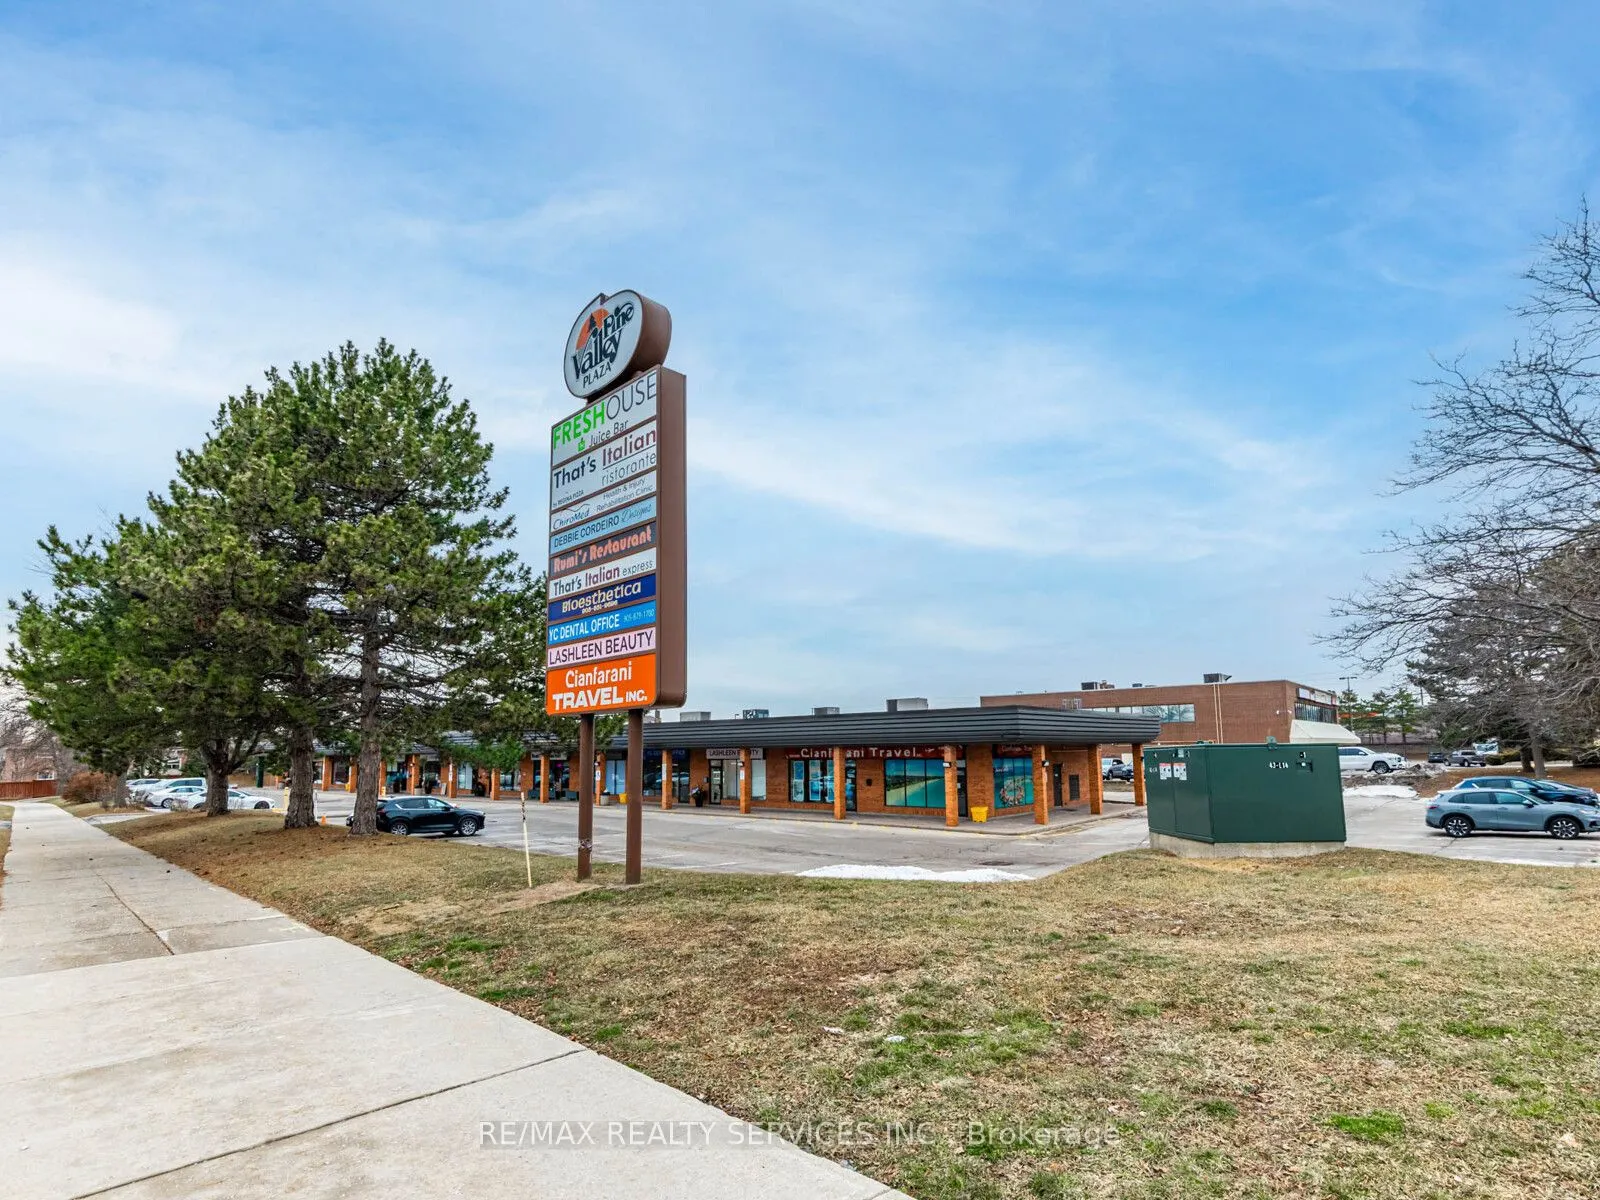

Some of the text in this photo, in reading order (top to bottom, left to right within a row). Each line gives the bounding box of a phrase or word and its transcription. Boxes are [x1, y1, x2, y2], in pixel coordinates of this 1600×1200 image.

[603, 302, 634, 339] Pine
[572, 327, 622, 379] Valley
[582, 361, 612, 388] PLAZA
[552, 371, 656, 450] FRESHOUSE
[589, 419, 629, 448] Juice Bar
[553, 429, 656, 488] That's Italian
[601, 452, 656, 486] ristorante
[554, 531, 579, 548] DEBBIE
[580, 515, 620, 538] CORDEIRO
[553, 525, 652, 573] Rumi's Restaurant
[553, 560, 654, 596] That's Italian express
[549, 627, 559, 641] YC
[560, 623, 589, 640] DENTAL
[591, 613, 620, 633] OFFICE
[549, 630, 654, 665] LASHLEEN BEAUTY
[565, 660, 632, 688] Cianfarani
[552, 686, 648, 711] TRAVEL INC.
[869, 747, 917, 758] Travel
